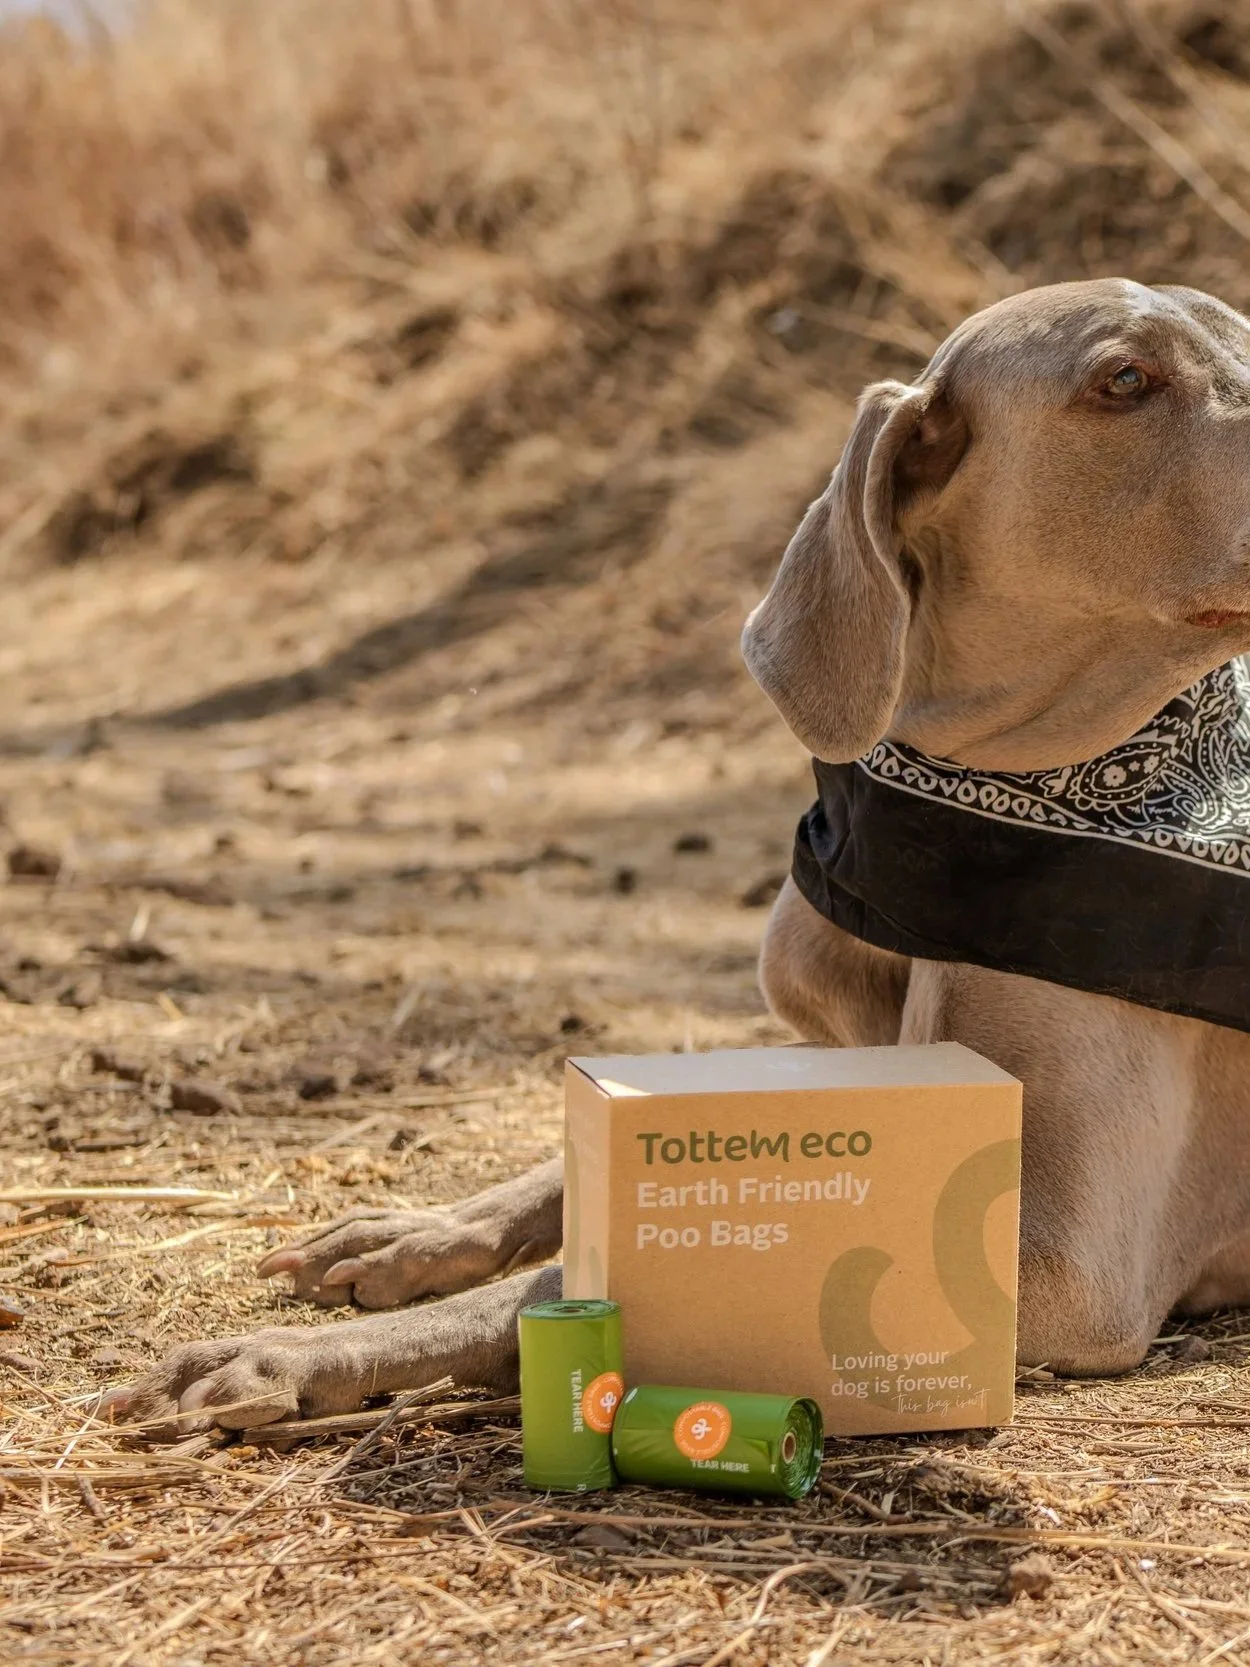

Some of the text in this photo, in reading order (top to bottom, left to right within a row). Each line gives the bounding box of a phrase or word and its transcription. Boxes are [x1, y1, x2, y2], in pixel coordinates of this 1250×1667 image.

[800, 1130, 872, 1158] eco
[637, 1171, 872, 1208] Earth Friendly
[636, 1219, 789, 1251] Poo Bags
[831, 1351, 949, 1371] Loving your
[831, 1374, 972, 1398] dog is forever,
[571, 1368, 584, 1433] TEAR HERE
[891, 1393, 921, 1416] This
[926, 1395, 951, 1418] bag
[690, 1458, 750, 1473] TEAR HERE
